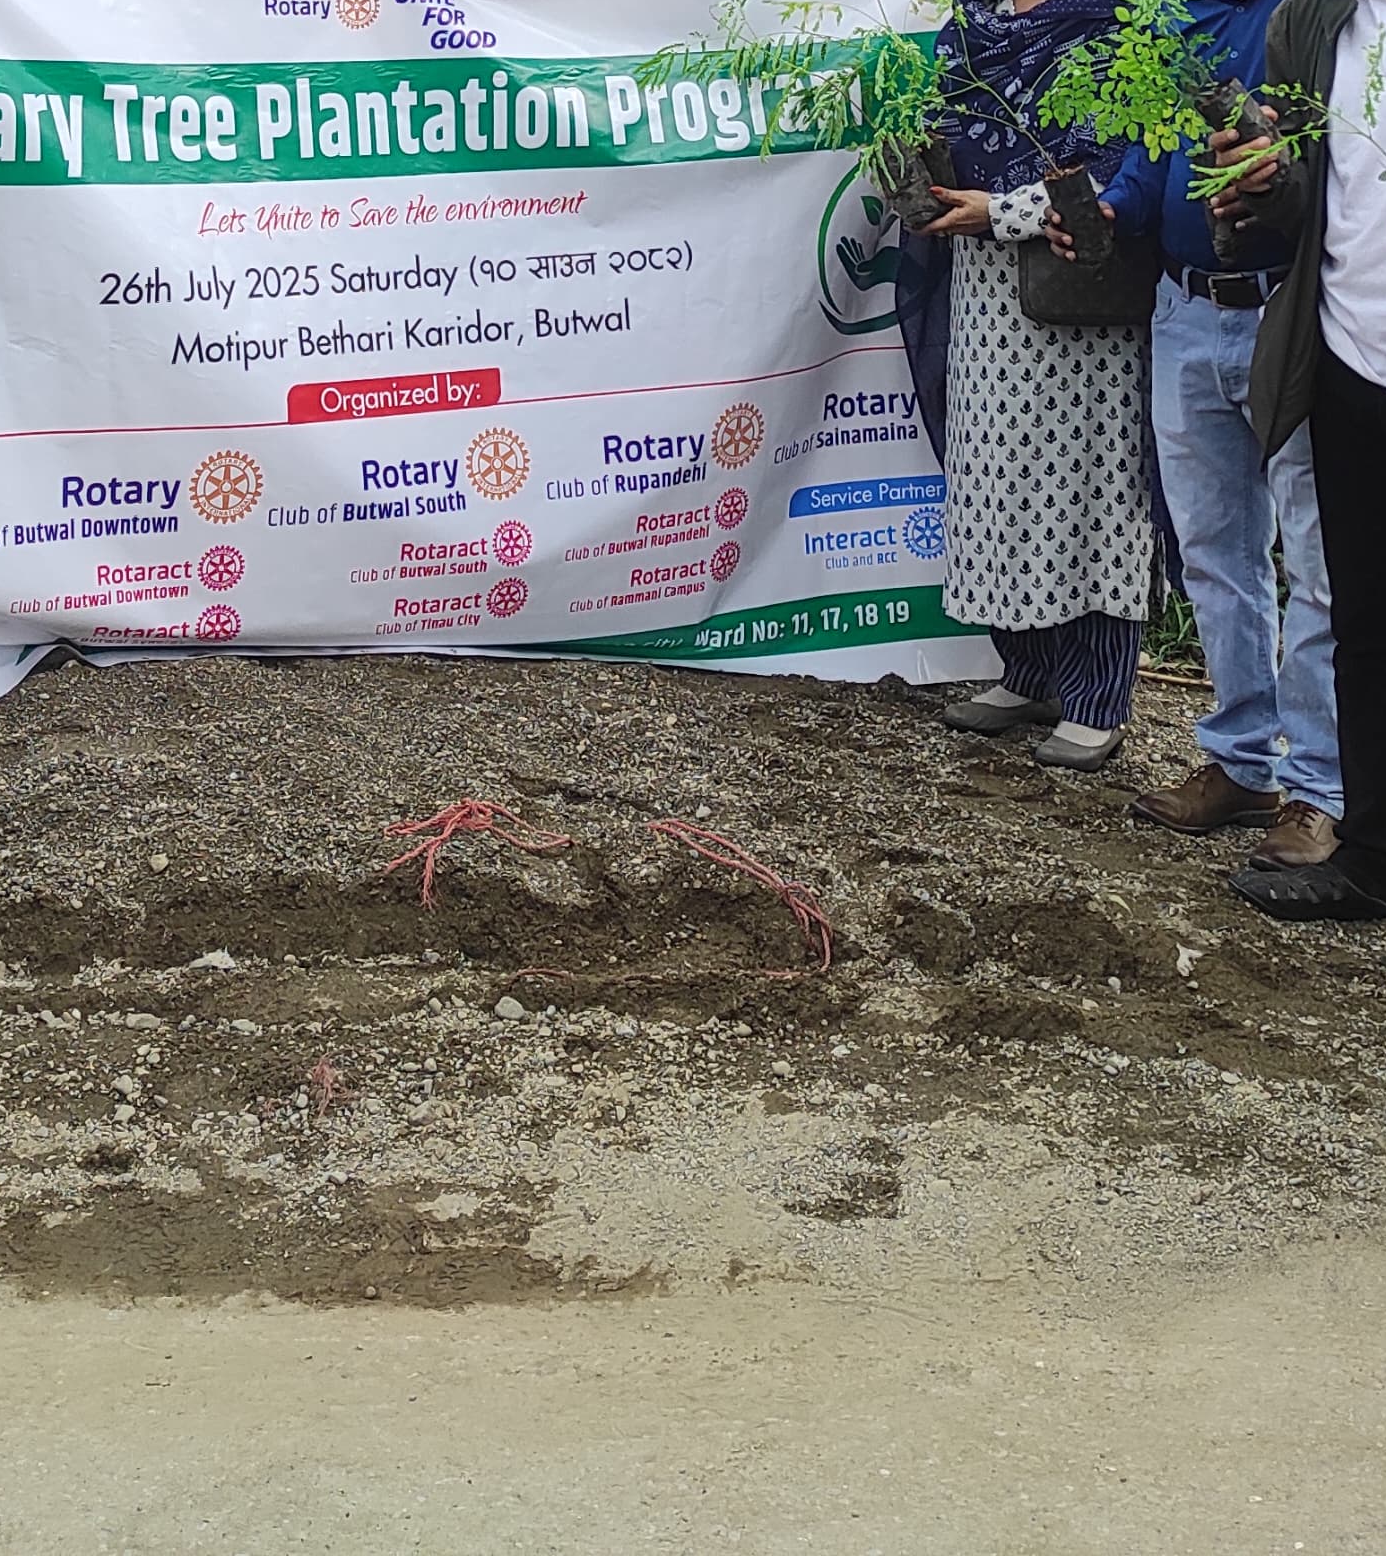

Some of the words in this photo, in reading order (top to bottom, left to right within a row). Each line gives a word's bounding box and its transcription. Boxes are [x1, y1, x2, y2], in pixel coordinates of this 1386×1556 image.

[422, 7, 465, 26] FOR
[430, 30, 496, 49] GOOD
[104, 84, 237, 162] Tree
[256, 70, 589, 160] Plantation
[198, 202, 245, 236] Lets
[254, 203, 313, 240] Unite
[321, 205, 340, 229] to
[349, 198, 398, 227] Save
[406, 194, 438, 225] the
[445, 190, 589, 222] environment
[99, 267, 171, 305] 26th
[183, 265, 235, 310] July
[245, 265, 320, 299] 2025
[330, 254, 459, 296] Saturday
[469, 255, 516, 287] (१०
[526, 252, 597, 279] साउन
[608, 240, 694, 274] २०८२)
[171, 330, 288, 371] Motipur
[298, 319, 394, 357] Bethari
[404, 309, 524, 349] Karidor,
[535, 298, 631, 338] Butwal
[320, 375, 438, 417] Organized
[446, 373, 481, 407] by:
[823, 392, 916, 421] Rotary
[603, 434, 705, 465] Rotary
[774, 442, 798, 464] Club
[802, 434, 816, 453] of
[816, 423, 918, 448] Sainamaina
[362, 459, 459, 490] Rotary
[546, 478, 584, 500] Club
[591, 475, 608, 495] of
[615, 463, 706, 493] Rupandehi
[62, 476, 181, 510] Rotary
[811, 486, 873, 508] Service
[879, 483, 943, 501] Partner
[268, 506, 309, 526] Club
[317, 504, 337, 524] of
[343, 497, 409, 522] Butwal
[416, 491, 466, 514] South
[636, 505, 710, 533] Rotaract
[14, 522, 74, 545] Butwal
[82, 516, 178, 539] Downtown
[565, 547, 589, 561] Club
[593, 543, 605, 557] of
[608, 536, 647, 555] Butwal
[651, 525, 710, 547] Rupandehi
[805, 526, 897, 554] Interact
[401, 538, 487, 561] Rotaract
[825, 556, 849, 569] Club
[853, 554, 873, 566] and
[877, 552, 898, 564] RCC
[97, 561, 192, 586] Rotaract
[350, 569, 377, 583] Club
[383, 567, 396, 580] of
[400, 563, 445, 579] Butwal
[449, 560, 487, 575] South
[630, 560, 706, 587] Rotaract
[10, 599, 40, 614] Club
[46, 597, 60, 612] of
[64, 591, 111, 610] Butwal
[117, 585, 189, 604] Downtown
[394, 593, 482, 617] Rotaract
[569, 598, 593, 613] Club
[597, 596, 609, 609] of
[664, 581, 705, 598] Campus
[93, 622, 190, 639] Rotaract
[376, 623, 401, 635] Club
[405, 620, 418, 632] of
[420, 617, 453, 631] Tinau
[457, 614, 480, 628] City
[694, 624, 744, 649] Ward
[752, 621, 785, 644] No:
[792, 613, 813, 636] 11,
[820, 607, 848, 633] 17,
[853, 604, 878, 627] 18
[885, 601, 910, 624] 19
